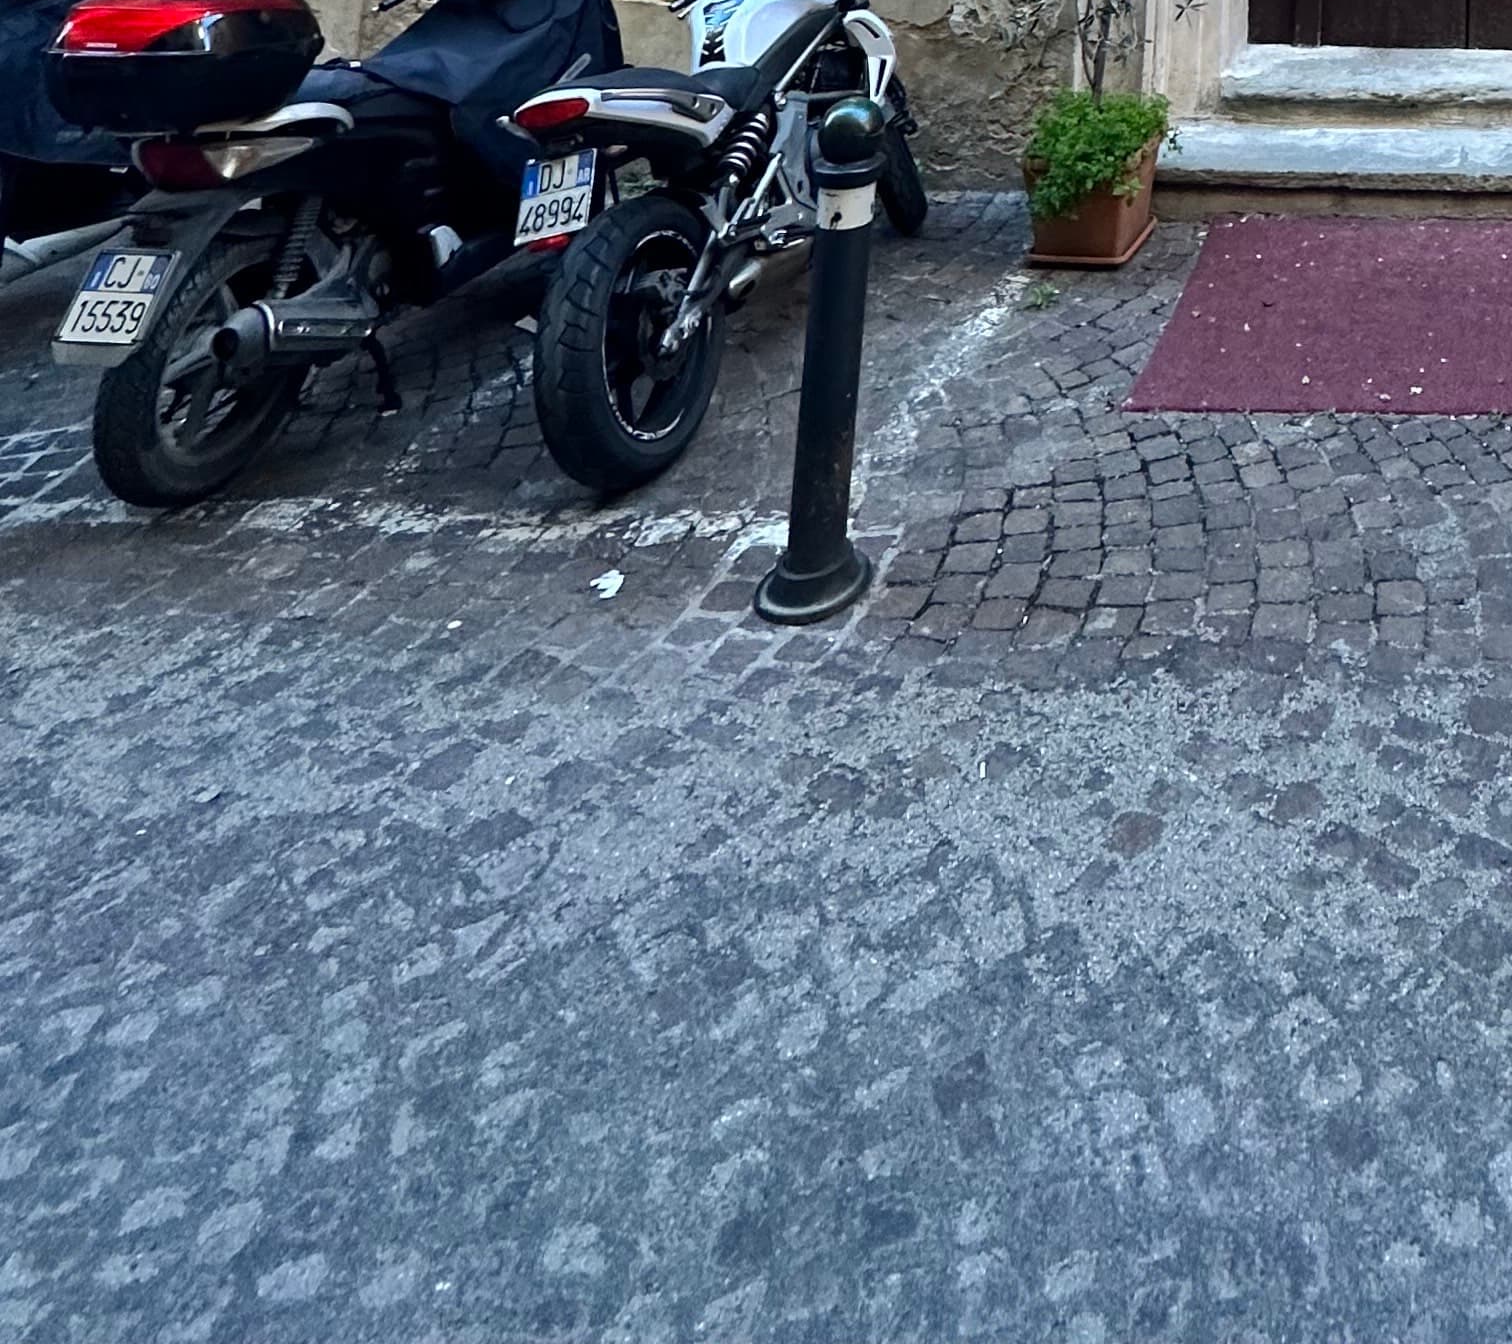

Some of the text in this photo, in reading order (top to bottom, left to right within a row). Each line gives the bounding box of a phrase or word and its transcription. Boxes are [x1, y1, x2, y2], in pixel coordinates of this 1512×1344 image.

[539, 160, 566, 193] DJ
[519, 192, 586, 235] 48994
[104, 257, 143, 288] CJ
[70, 300, 146, 334] 15539
